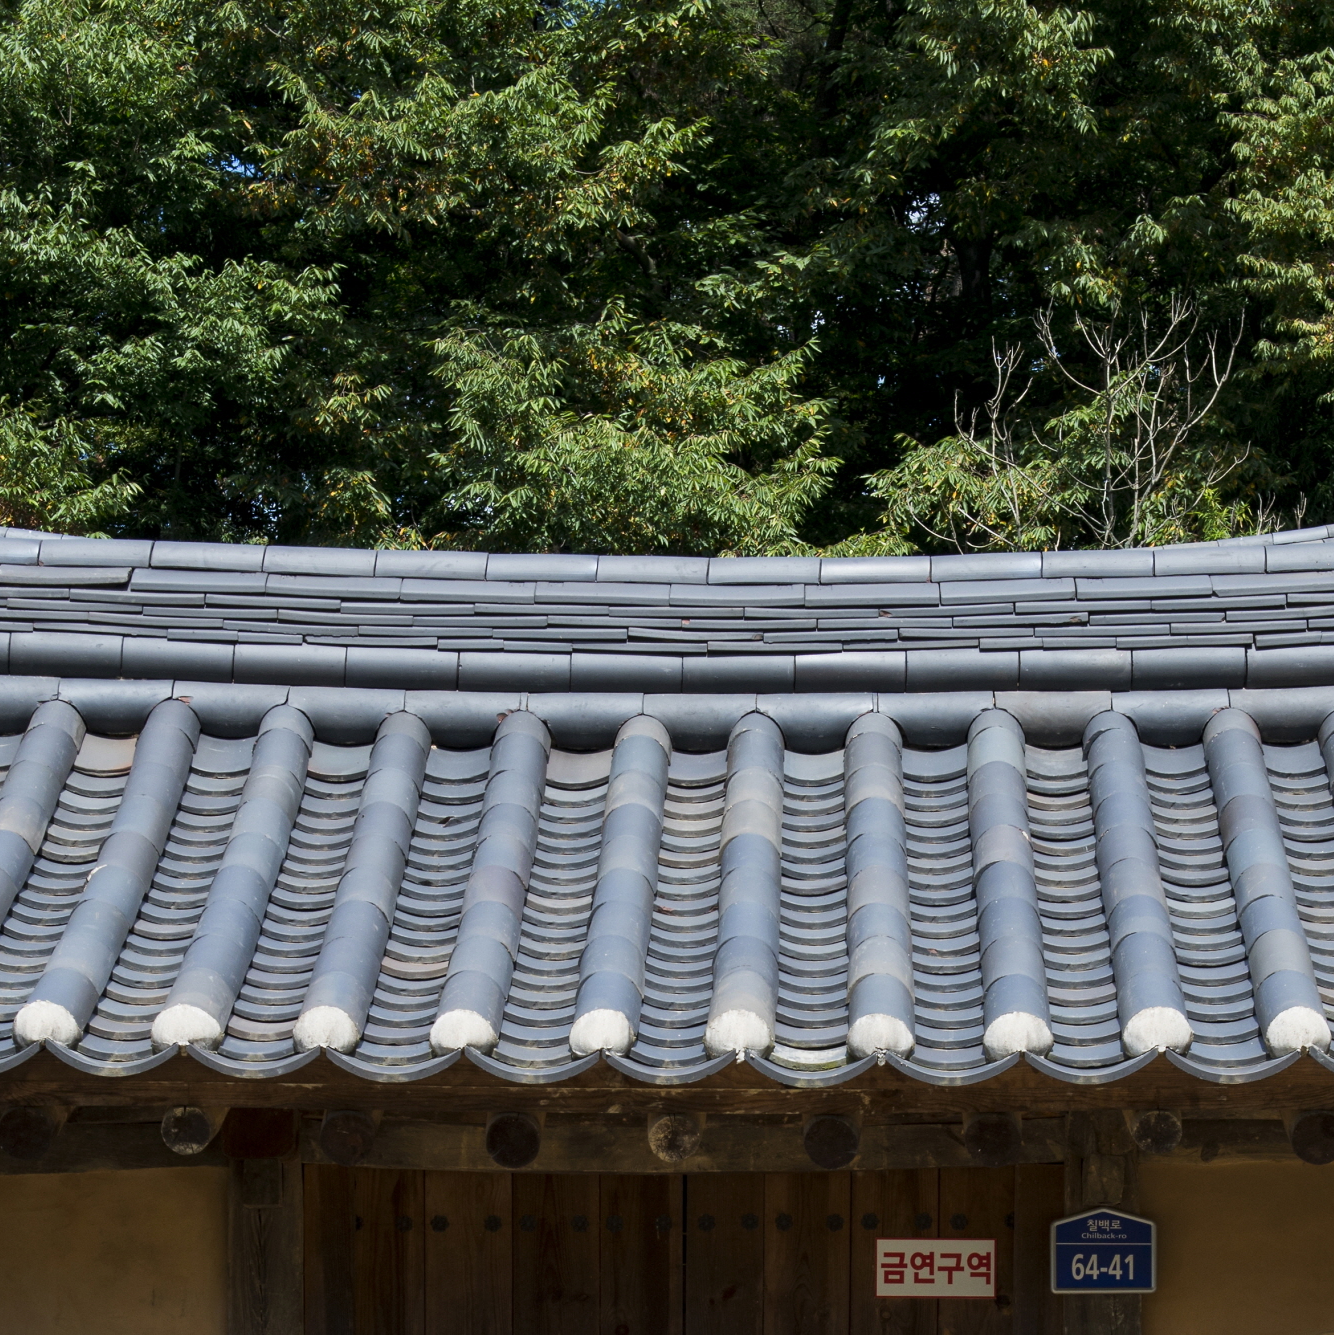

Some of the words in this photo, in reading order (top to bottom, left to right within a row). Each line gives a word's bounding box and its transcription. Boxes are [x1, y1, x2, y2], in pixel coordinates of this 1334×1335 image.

[1086, 1218, 1123, 1232] 칠백로
[1080, 1232, 1128, 1240] Chilback-ro
[880, 1252, 992, 1284] 금연구역
[1071, 1253, 1135, 1280] 64-41
